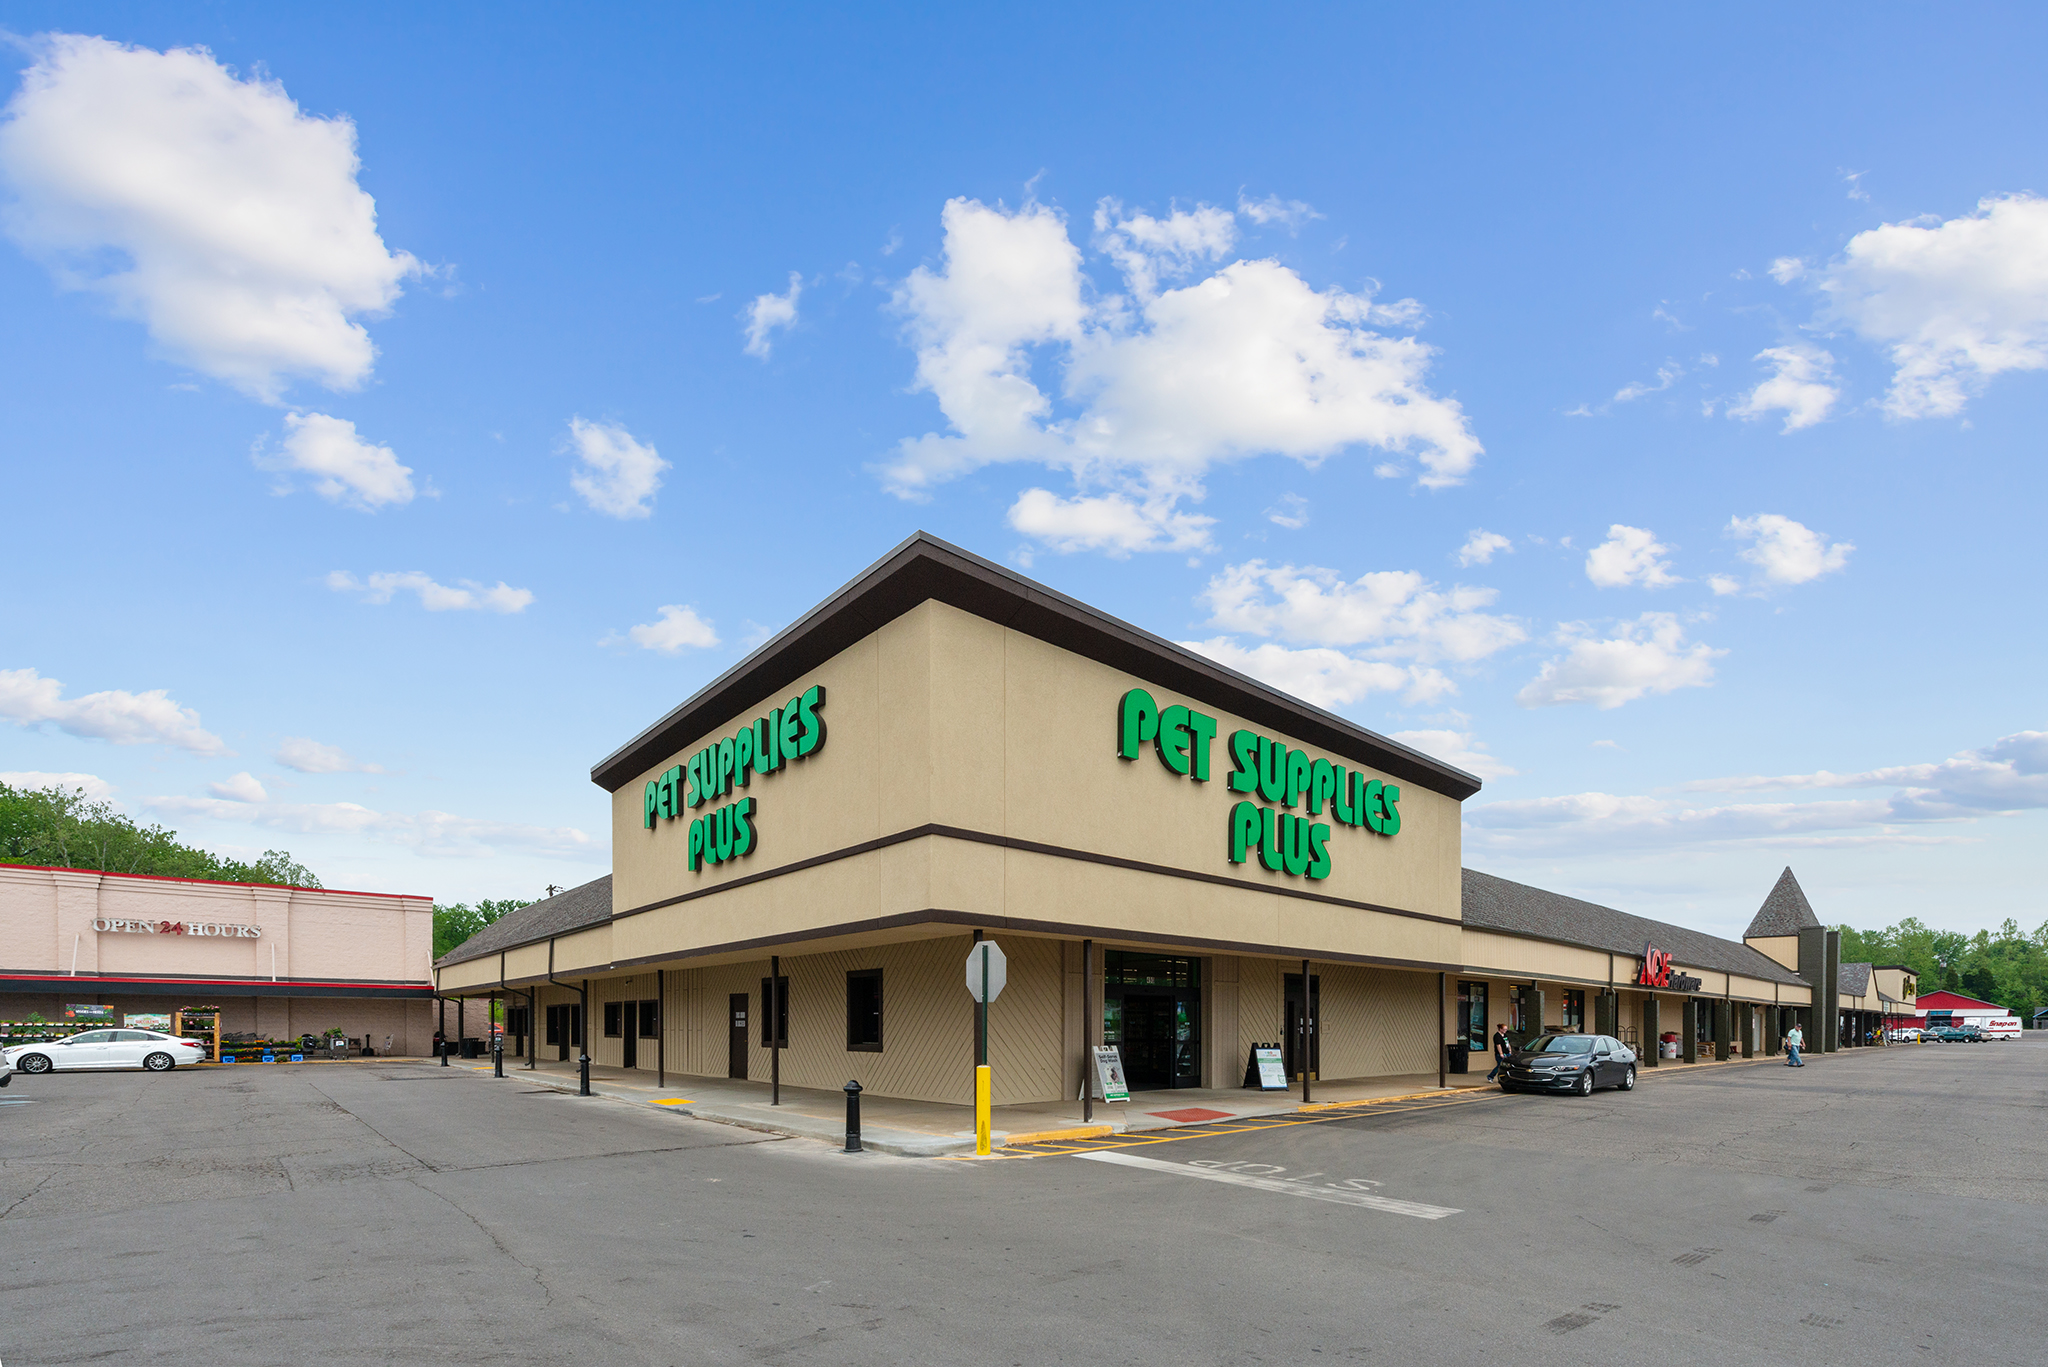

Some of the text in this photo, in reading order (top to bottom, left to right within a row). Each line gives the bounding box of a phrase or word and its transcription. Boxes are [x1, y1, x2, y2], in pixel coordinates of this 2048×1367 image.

[644, 684, 827, 829] PET SUPPLIES
[1117, 688, 1401, 836] PET SUPPLIES
[688, 796, 757, 871] PLUS
[1228, 801, 1332, 880] PLUS
[91, 917, 262, 939] OPEN 24 HOURS
[1637, 941, 1673, 988] ACE
[1989, 1020, 2017, 1028] Snap-on
